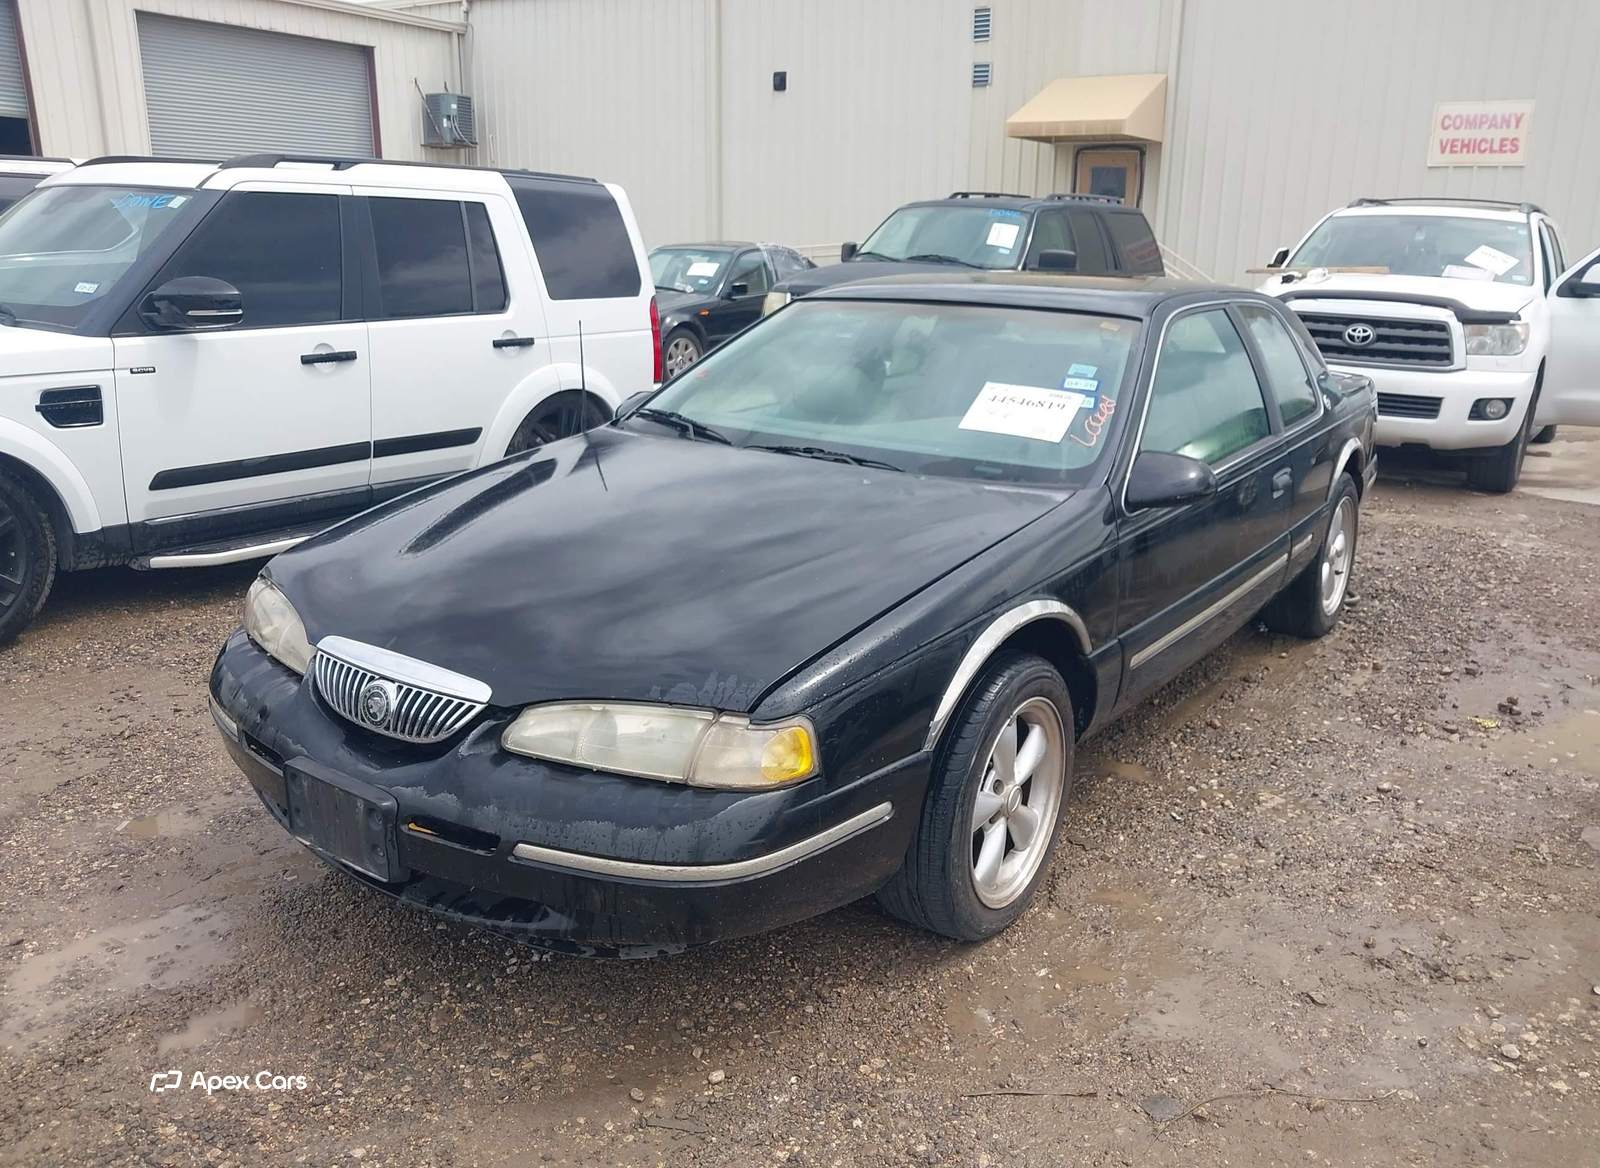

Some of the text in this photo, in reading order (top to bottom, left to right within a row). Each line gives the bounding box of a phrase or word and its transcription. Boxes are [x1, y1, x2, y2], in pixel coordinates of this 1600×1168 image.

[1440, 112, 1525, 131] COMPANY
[1439, 137, 1520, 154] VEHICLES
[1066, 380, 1096, 389] 04-26
[988, 394, 1067, 411] 44546819
